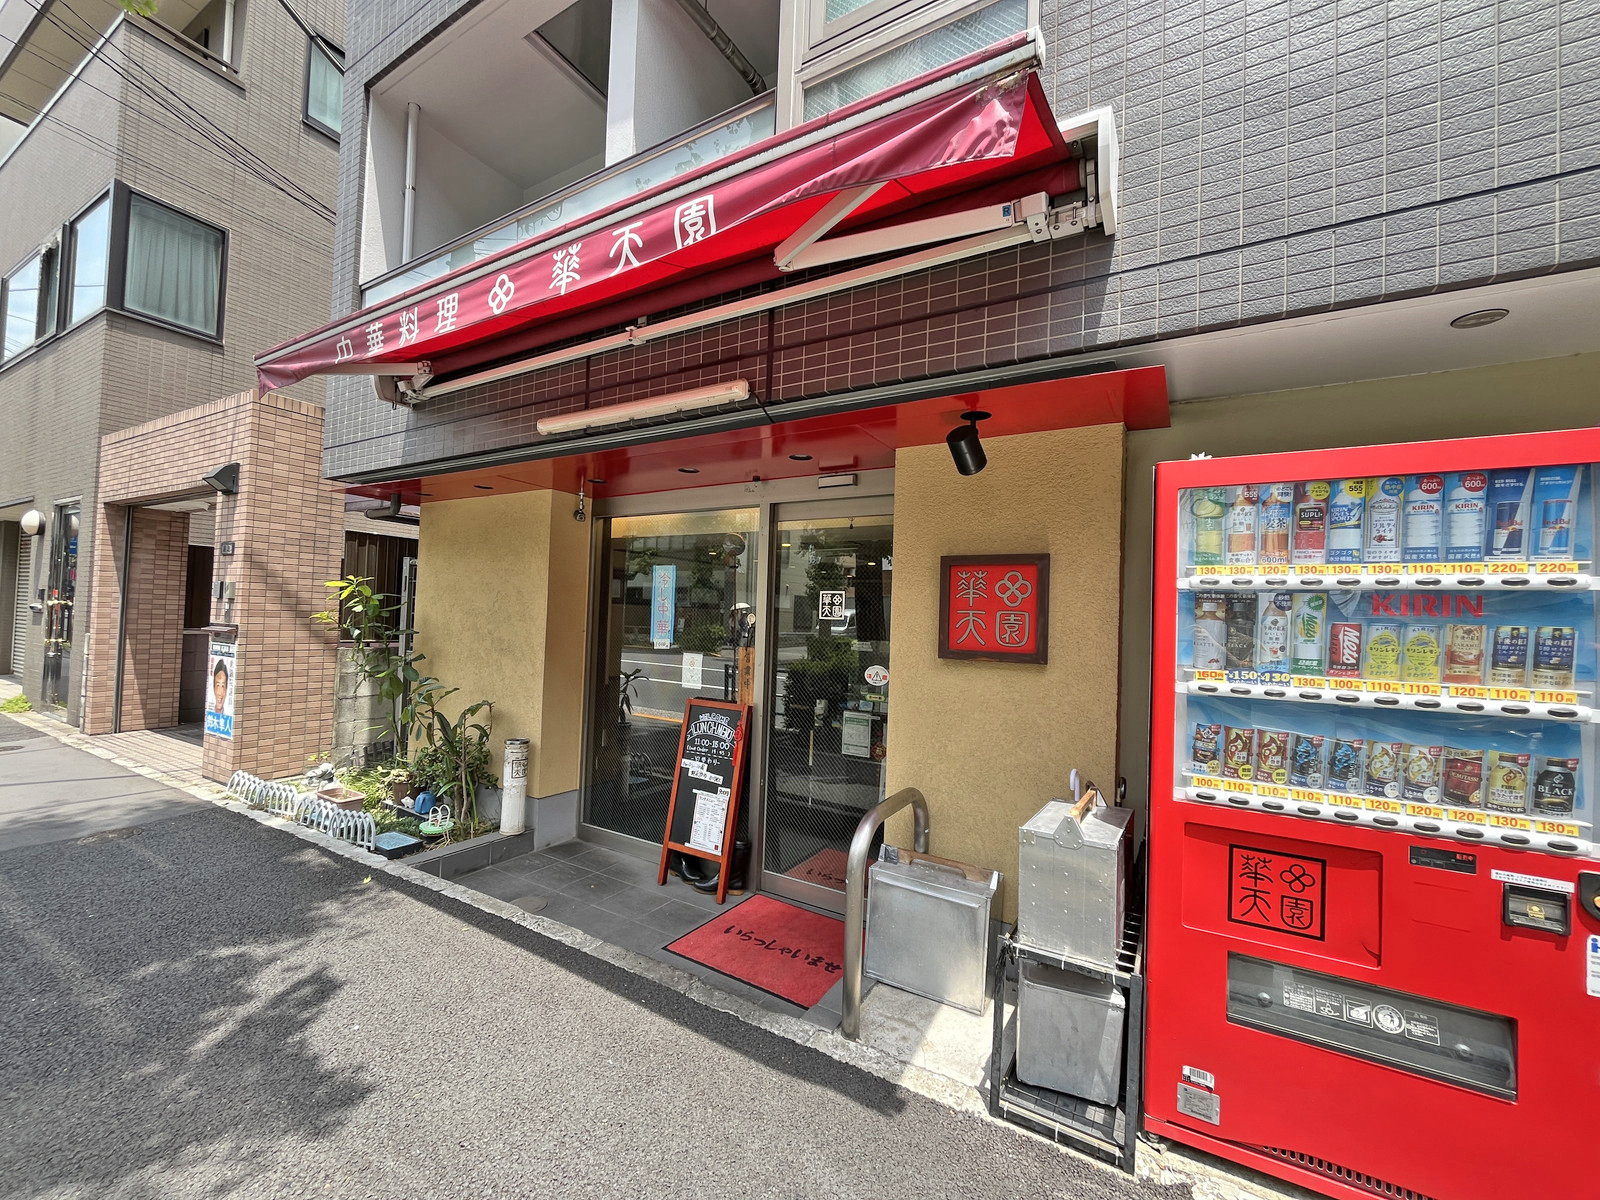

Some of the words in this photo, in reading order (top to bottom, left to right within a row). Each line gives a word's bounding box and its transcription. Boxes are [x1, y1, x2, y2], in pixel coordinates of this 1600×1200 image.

[548, 194, 716, 295] 華天園
[1262, 566, 1286, 574] 120円
[1299, 566, 1324, 574] 130円
[1333, 565, 1360, 574] 130円
[1372, 565, 1399, 574] 130円
[1412, 565, 1441, 574] 110円
[1450, 564, 1481, 574] 110円
[1491, 563, 1524, 573] 220円
[1539, 563, 1574, 573] 220円
[1371, 594, 1484, 618] KIRIN
[1343, 626, 1360, 664] Mets
[1297, 677, 1323, 687] 130円
[1333, 680, 1360, 689] 100円
[1371, 682, 1398, 692] 110円
[1409, 684, 1437, 694] 110円
[1454, 687, 1484, 697] 120円
[1495, 689, 1526, 700] 110円
[1540, 692, 1573, 703] 110円
[699, 712, 731, 725] WELCOME
[691, 721, 718, 736] LUNCH
[1196, 777, 1219, 788] 100円
[1227, 780, 1251, 792] 110円
[1261, 786, 1285, 797] 110円
[1537, 784, 1573, 795] BLACK
[1296, 790, 1321, 802] 110円
[1332, 795, 1359, 807] 110円
[1369, 800, 1398, 812] 120円
[1411, 805, 1440, 817] 120円
[1453, 811, 1483, 823] 120円
[1494, 816, 1527, 829] 130円
[1540, 822, 1574, 835] 130円
[724, 925, 842, 974] いらっしゃいませ
